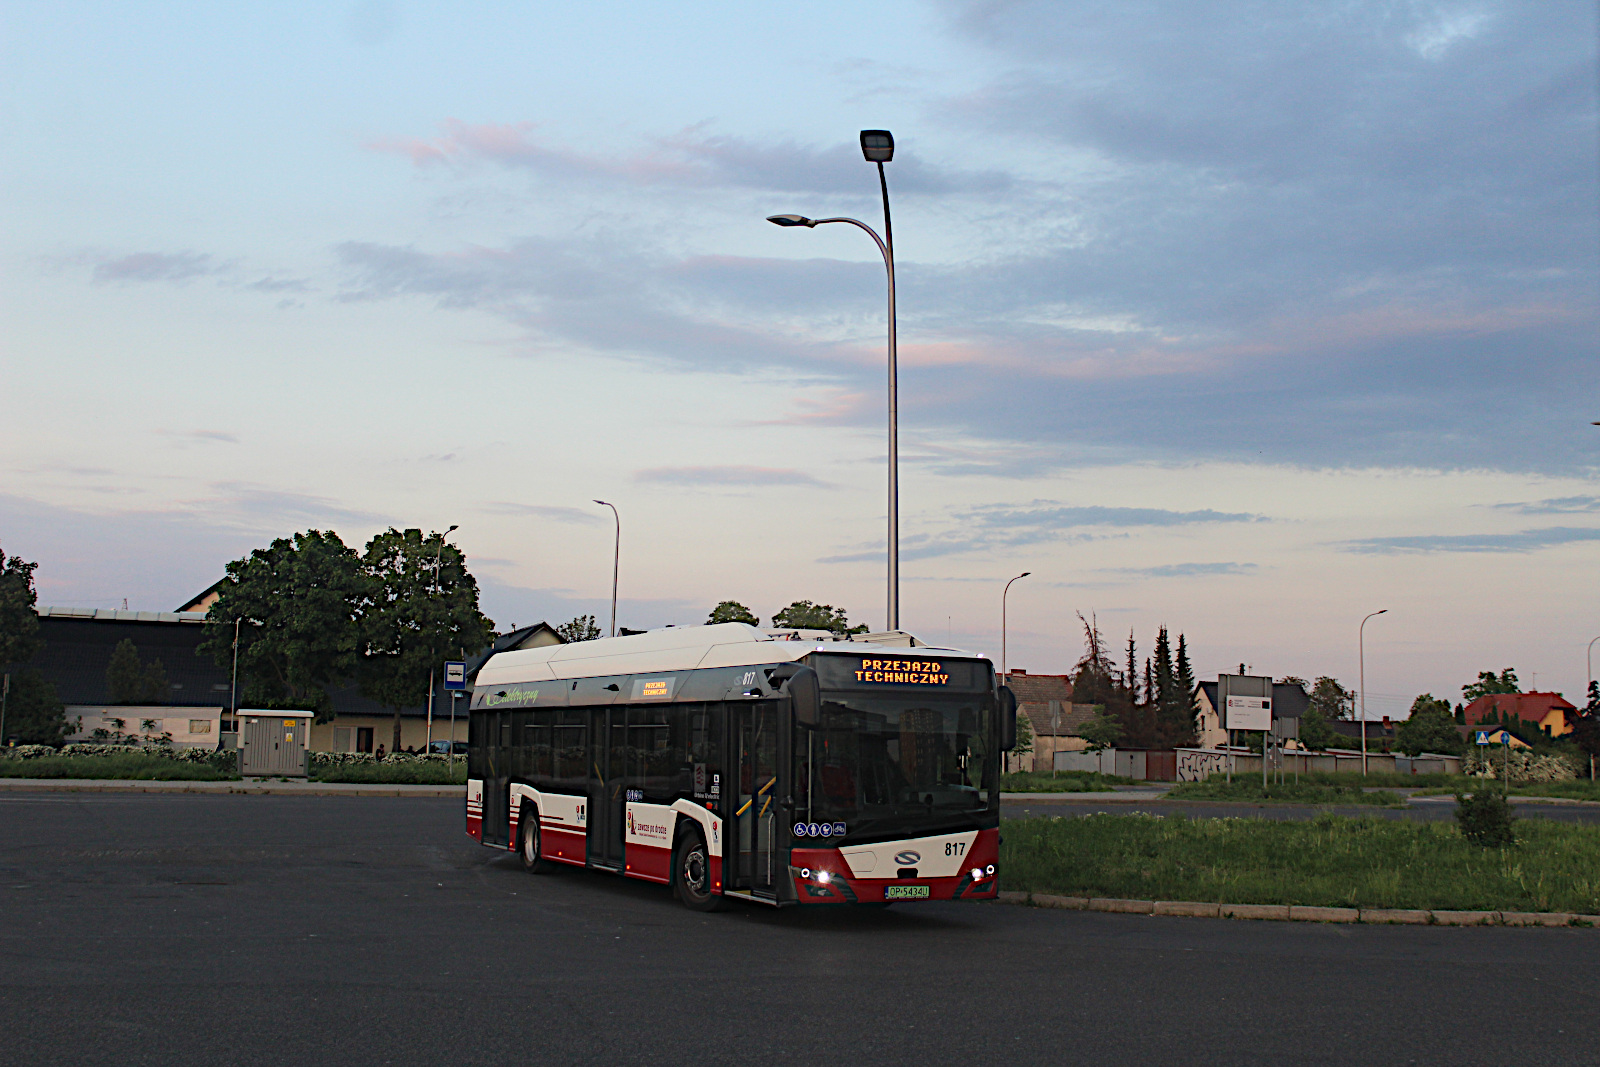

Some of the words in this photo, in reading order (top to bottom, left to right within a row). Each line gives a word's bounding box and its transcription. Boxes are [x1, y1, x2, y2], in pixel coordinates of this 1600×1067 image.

[862, 659, 941, 673] PRZEJAZD
[742, 672, 756, 685] 817
[854, 670, 949, 685] TECHNICZNY
[945, 843, 966, 856] 817
